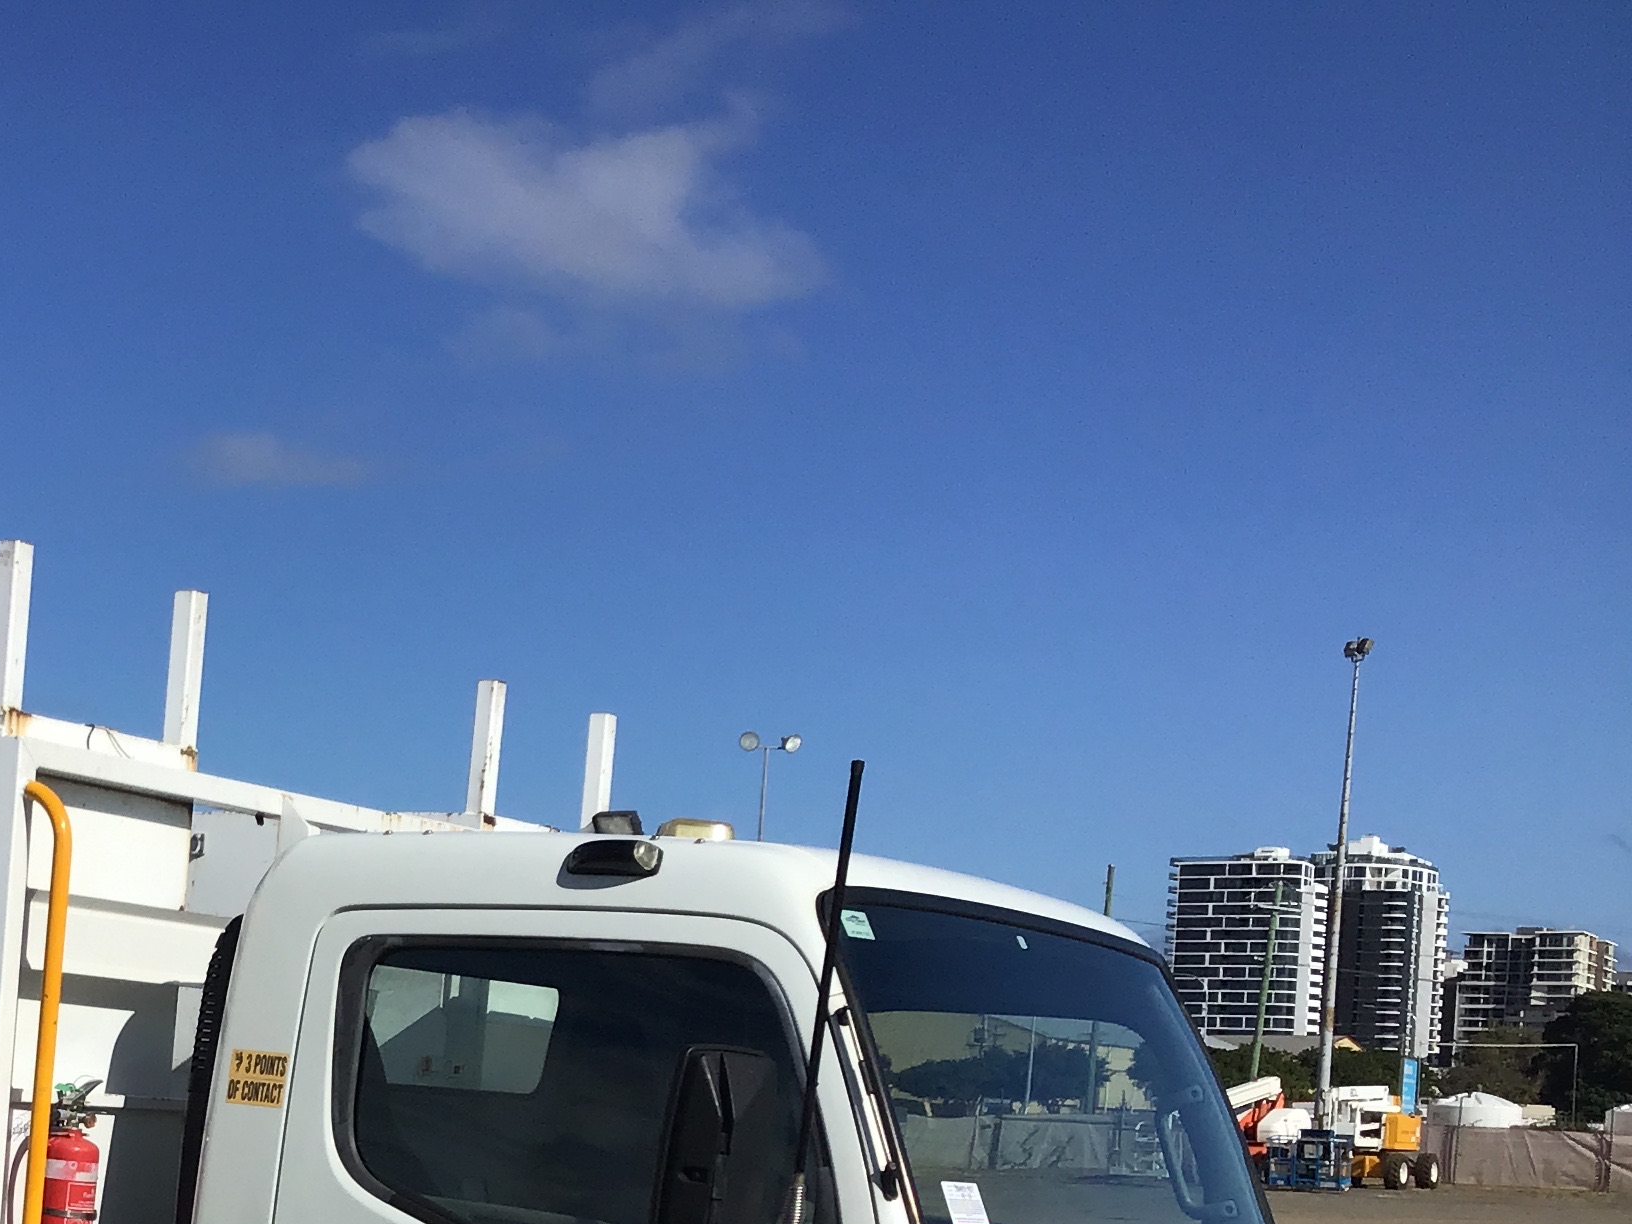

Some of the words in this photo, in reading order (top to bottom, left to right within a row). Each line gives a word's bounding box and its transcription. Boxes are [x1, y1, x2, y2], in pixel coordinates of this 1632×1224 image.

[245, 1053, 253, 1074] 3
[253, 1054, 288, 1077] POINTS
[227, 1079, 240, 1100] OF
[241, 1080, 284, 1105] CONTACT
